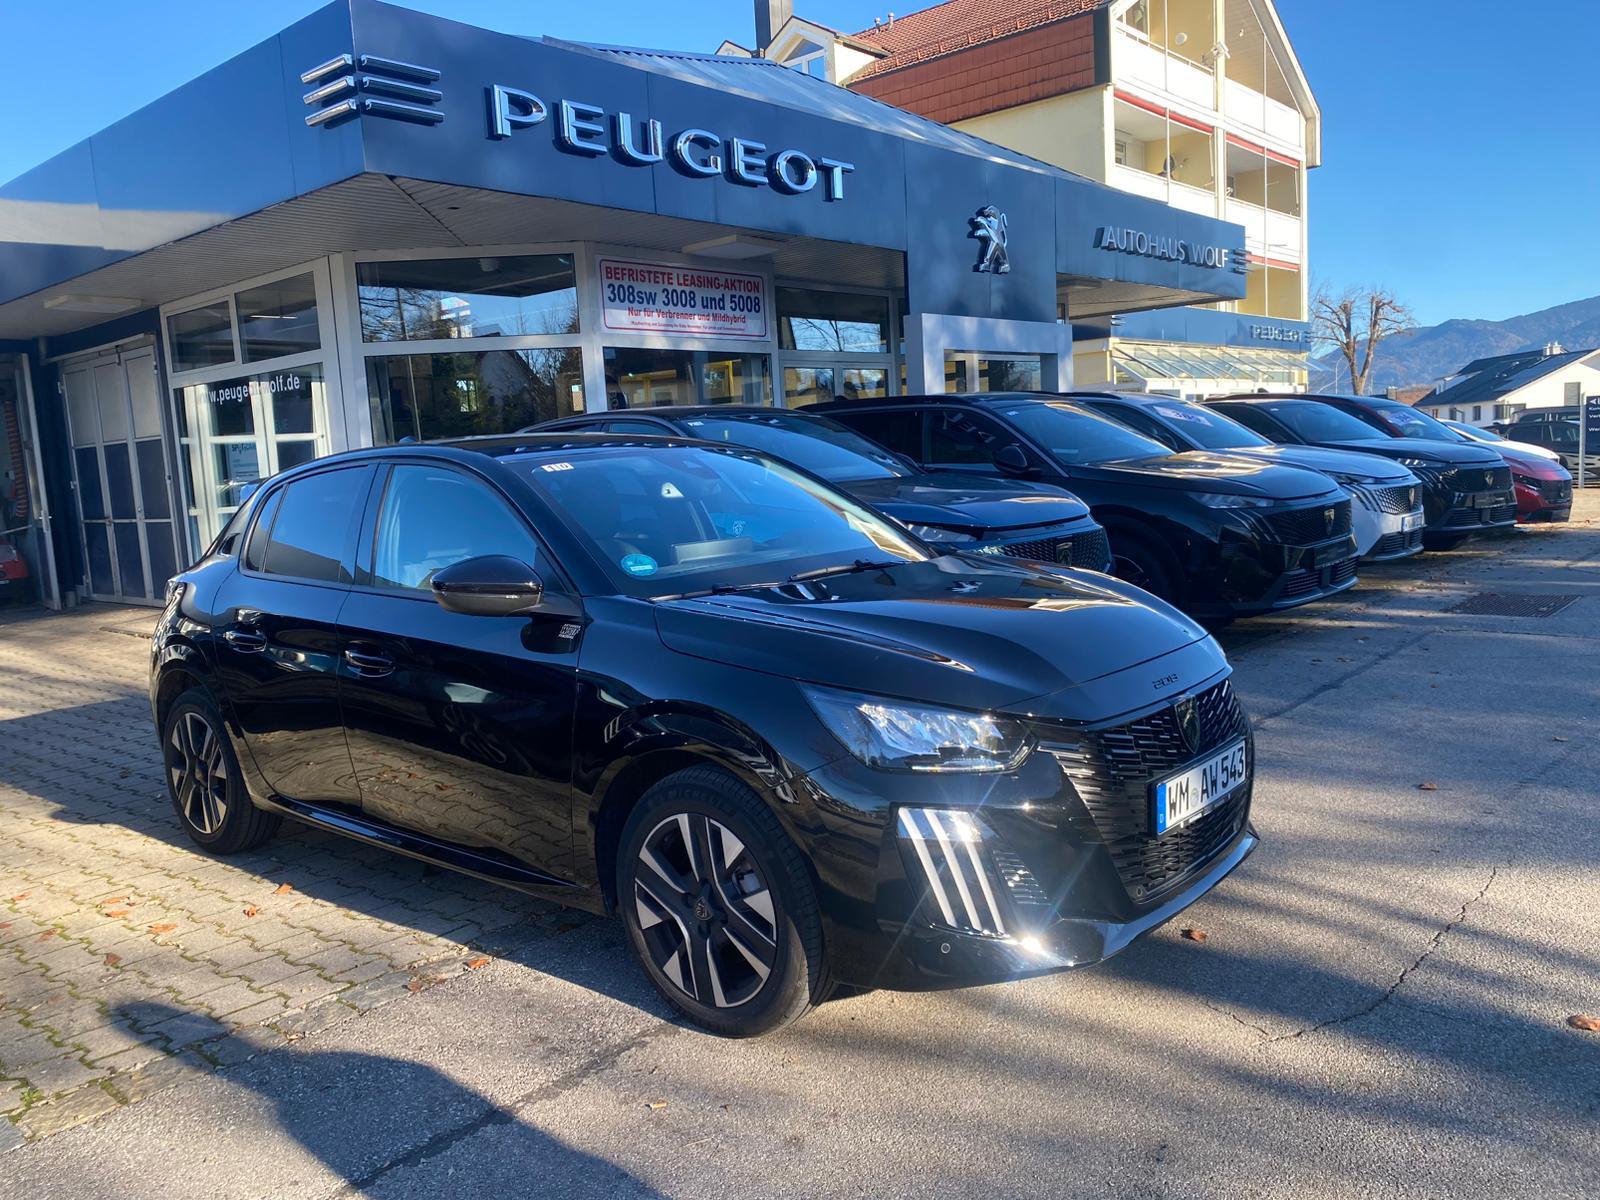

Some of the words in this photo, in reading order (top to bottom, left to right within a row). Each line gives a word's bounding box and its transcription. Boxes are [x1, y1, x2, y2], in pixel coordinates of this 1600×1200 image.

[490, 83, 855, 201] PEUGEOT
[1101, 226, 1185, 261] AUTOHAUS
[1191, 243, 1229, 268] WOLF
[605, 266, 673, 286] BEFRISTETE
[676, 273, 760, 293] LEASING-AKTION
[607, 283, 657, 306] 308sw
[662, 288, 697, 308] 3008
[701, 293, 726, 311] und
[730, 294, 761, 313] 5008
[627, 307, 642, 317] Nur
[643, 307, 654, 317] für
[655, 308, 696, 320] Verbrenner
[697, 311, 710, 321] und
[711, 312, 746, 325] Mildhybrid
[1168, 777, 1190, 820] WM
[1200, 761, 1218, 803] AW
[1221, 746, 1244, 789] 543
